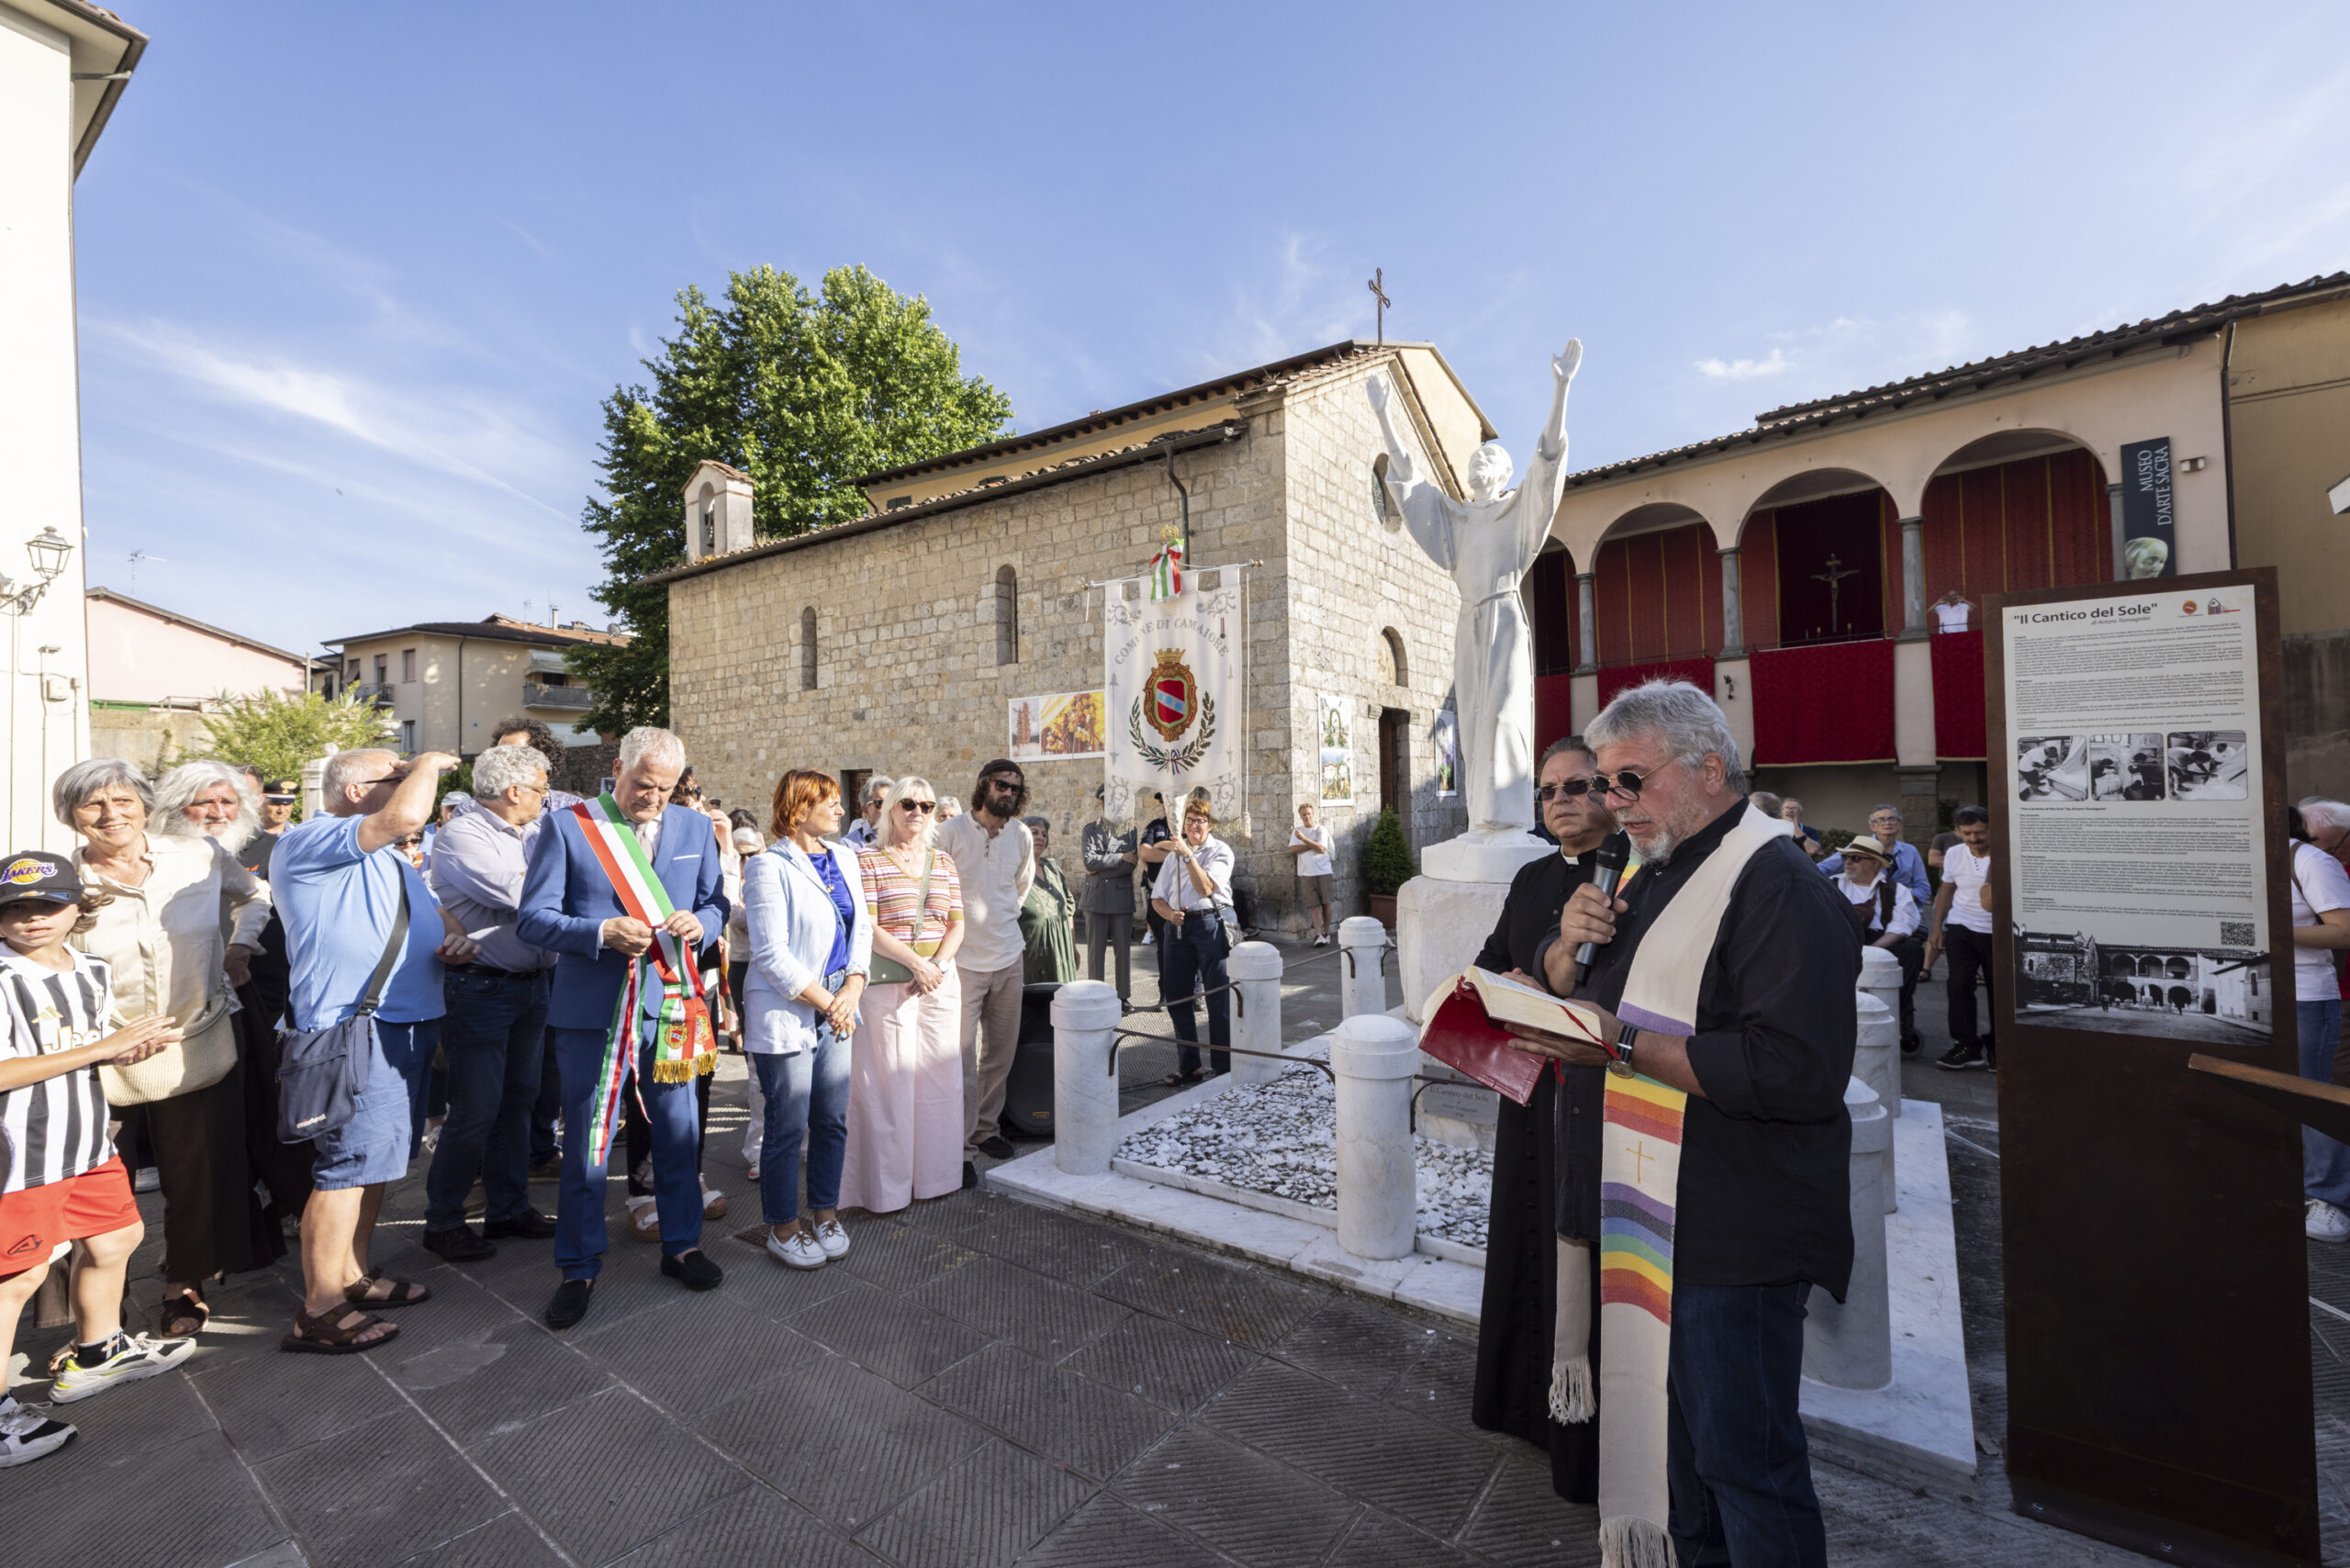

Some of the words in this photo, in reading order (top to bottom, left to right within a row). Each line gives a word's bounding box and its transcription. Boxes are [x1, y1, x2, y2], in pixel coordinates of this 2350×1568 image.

[2137, 450, 2154, 491] MUSEO
[2154, 445, 2169, 485] SACRA
[2155, 486, 2172, 526] D'ARTE
[2014, 614, 2028, 624] "Il
[2031, 610, 2087, 623] Cantico
[2090, 607, 2114, 619] del
[2118, 603, 2158, 616] Sole"
[1157, 619, 1169, 630] DI
[1174, 618, 1229, 657] CAMAIORE
[42, 1025, 103, 1052] Jee
[1436, 1086, 1461, 1098] Cantico
[1462, 1092, 1473, 1100] del
[1474, 1092, 1489, 1102] Sole
